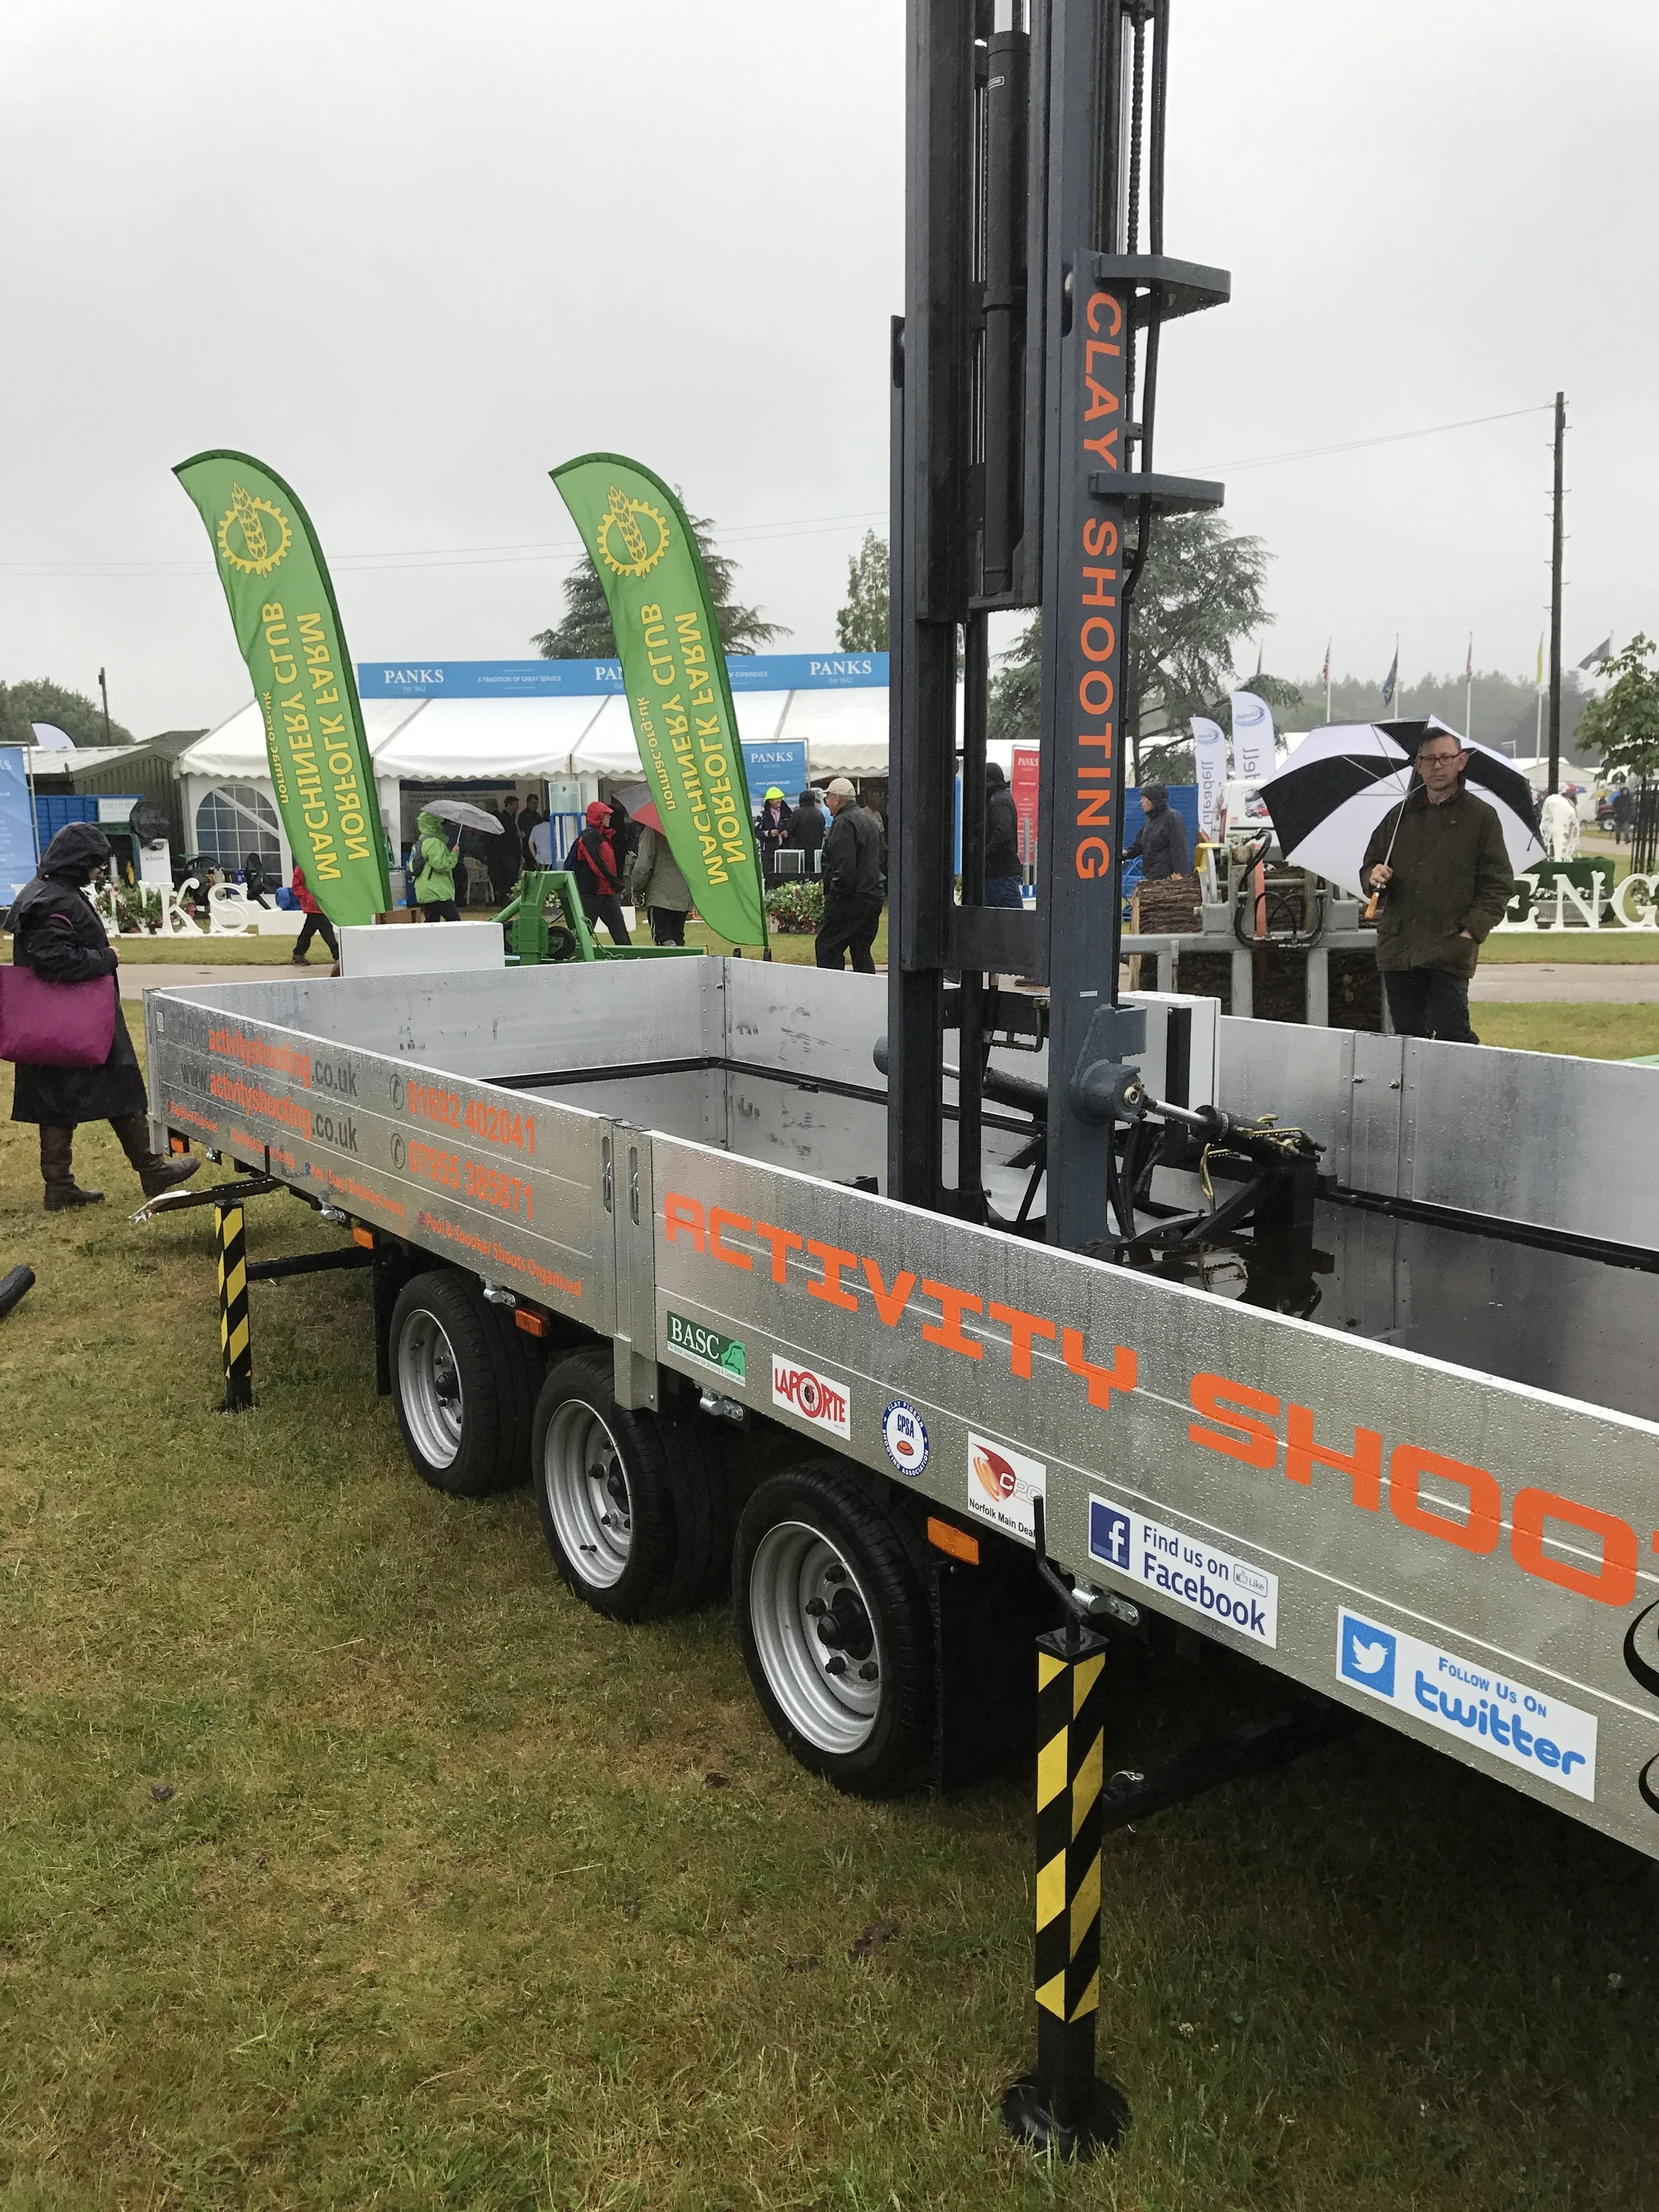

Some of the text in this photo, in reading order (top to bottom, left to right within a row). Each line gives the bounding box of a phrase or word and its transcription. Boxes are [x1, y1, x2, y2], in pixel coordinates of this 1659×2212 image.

[1076, 292, 1121, 879] CLAY SHOOTING
[384, 669, 444, 684] PANKS
[810, 660, 872, 676] PANKS
[751, 752, 794, 763] PANKS
[1017, 757, 1039, 767] PANKS
[407, 1079, 535, 1155] 01692 402041
[408, 1140, 534, 1220] 07955 385871
[528, 1258, 583, 1297] Organised
[671, 1317, 719, 1360] BASC
[665, 1192, 1659, 1607] ACTIVITY SHOO
[774, 1368, 845, 1422] LAPORTE
[888, 1400, 924, 1428] CLAY PIGEON
[897, 1414, 914, 1439] CPSA
[882, 1429, 929, 1476] SHOOTING ASSOCIATION
[970, 1497, 996, 1519] Norfolk
[998, 1511, 1017, 1529] Main
[1018, 1522, 1037, 1538] Deal
[1143, 1524, 1229, 1581] Find us on
[1143, 1551, 1266, 1636] Facebook
[1249, 1577, 1265, 1591] Like
[1414, 1670, 1586, 1775] twitter
